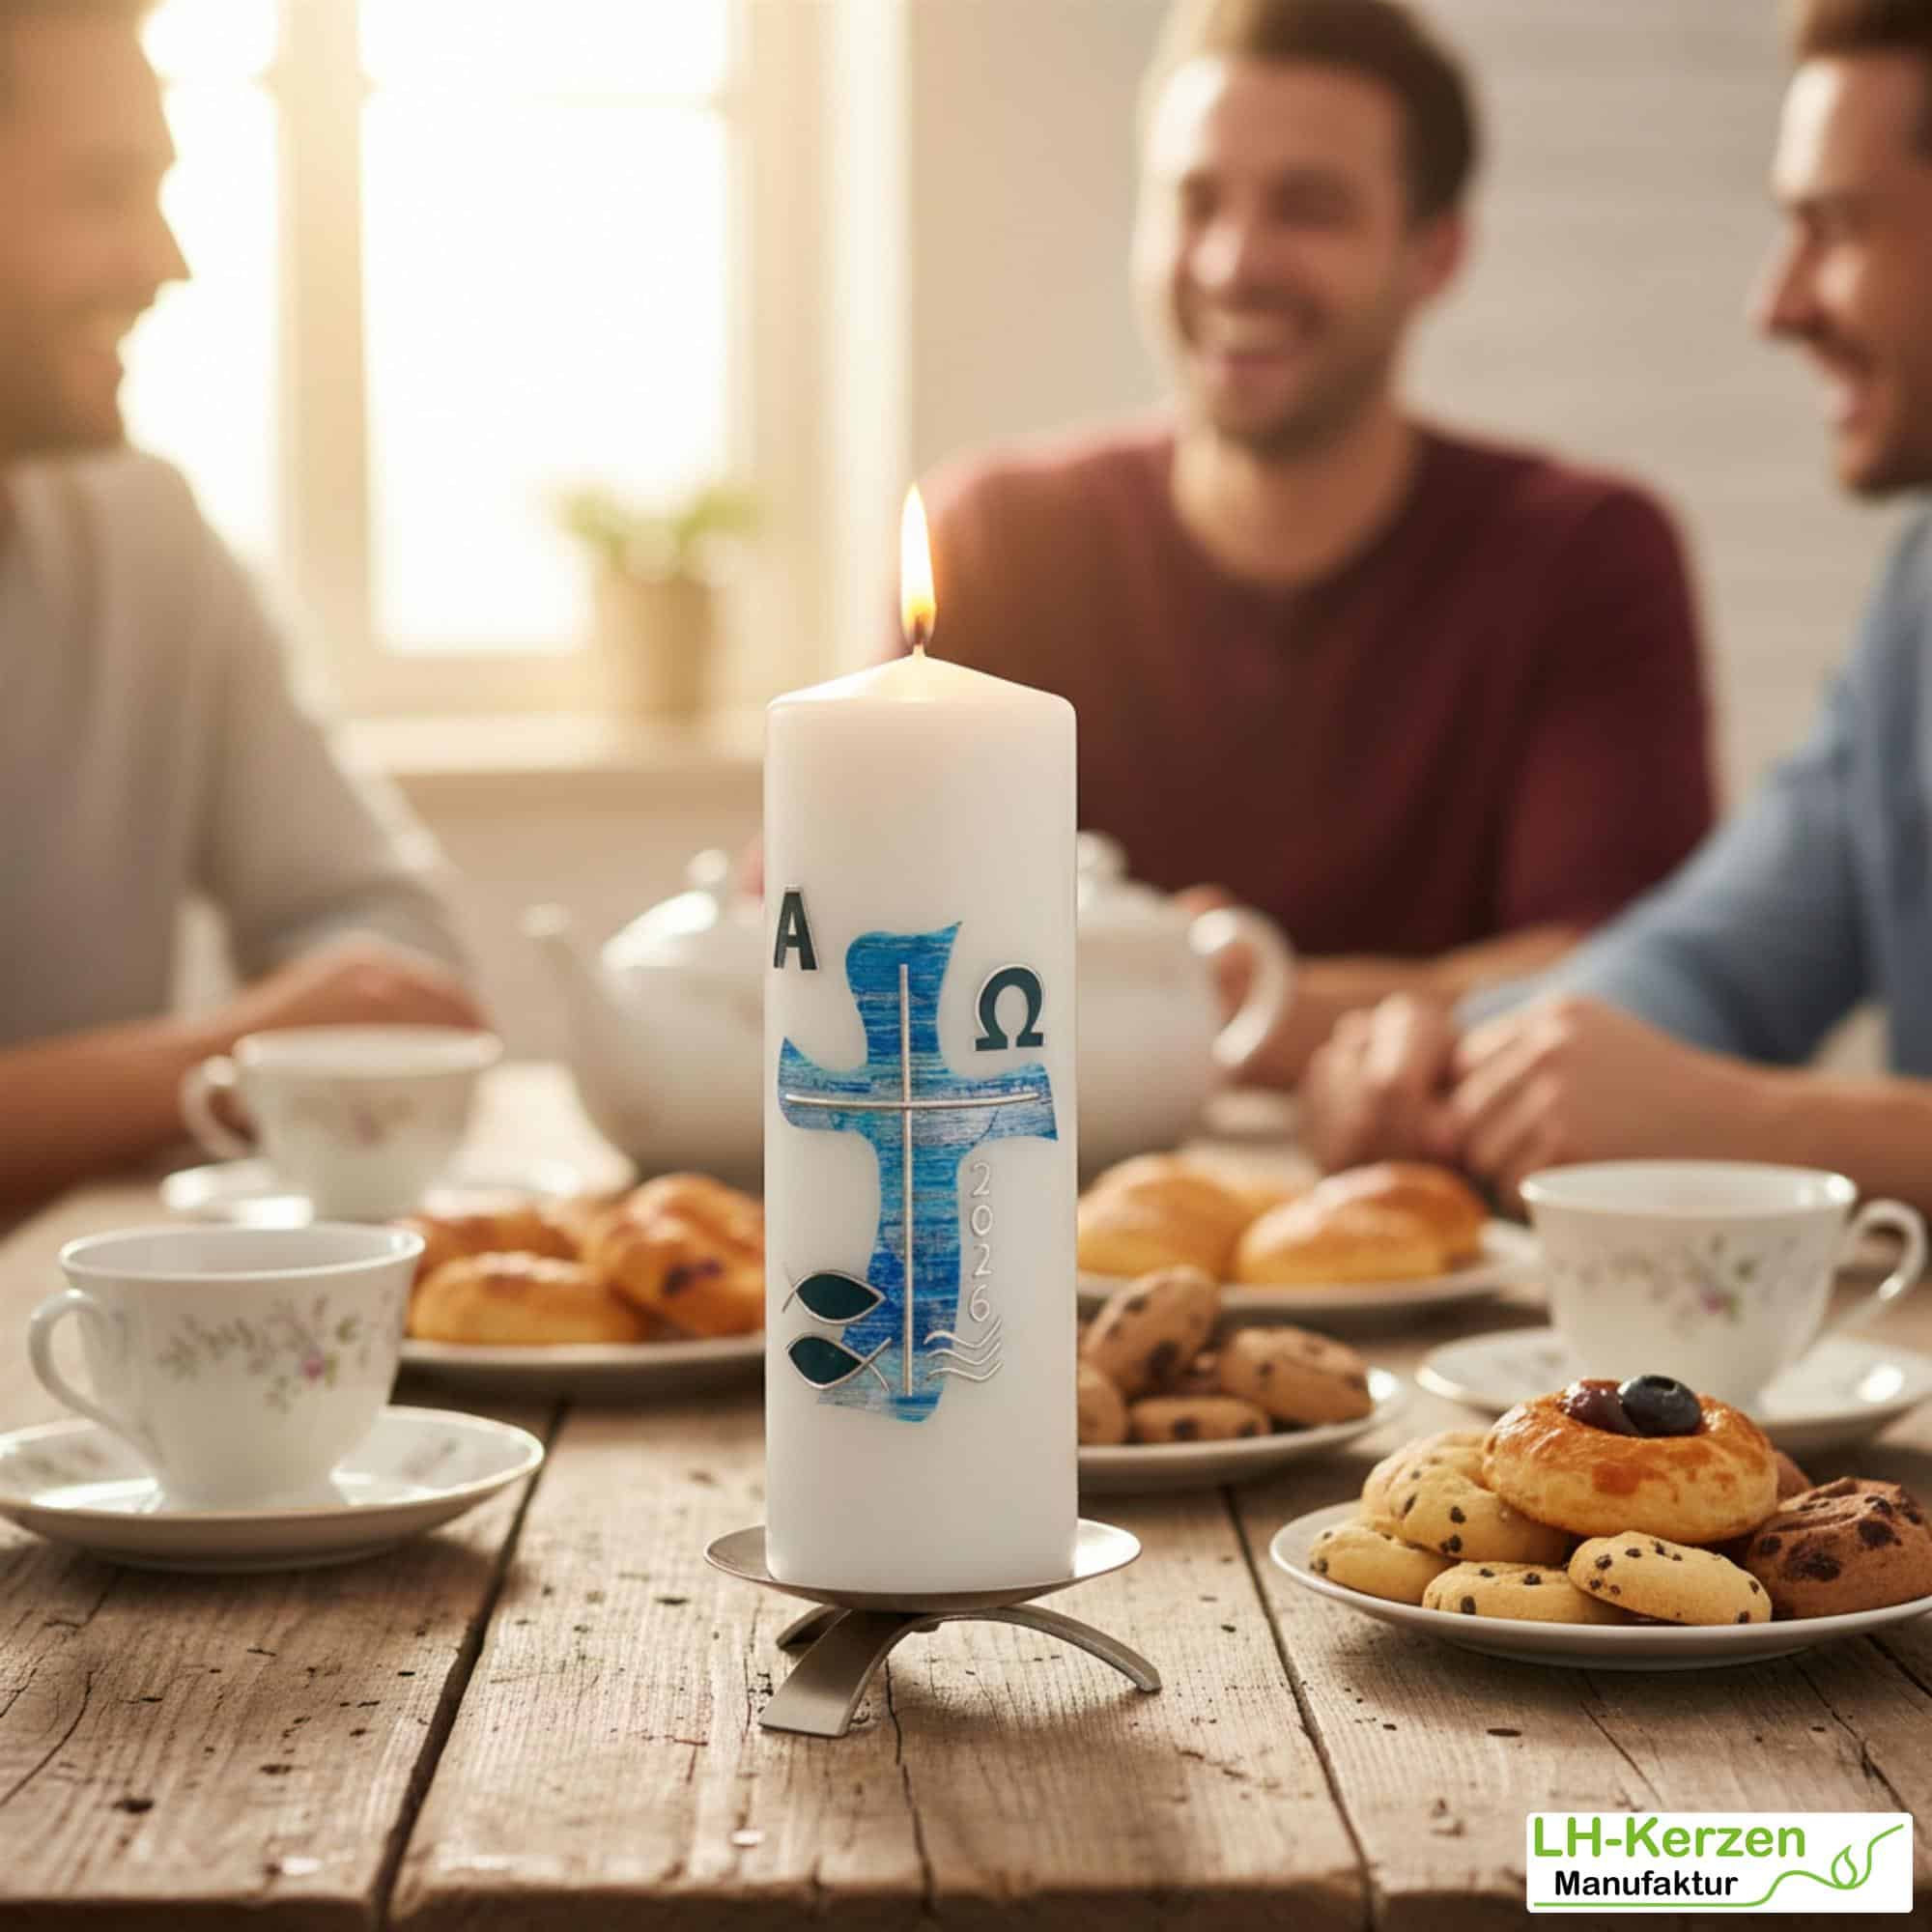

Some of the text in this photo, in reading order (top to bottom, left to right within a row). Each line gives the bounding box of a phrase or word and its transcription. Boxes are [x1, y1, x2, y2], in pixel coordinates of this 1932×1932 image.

[773, 889, 818, 971] A
[975, 965, 1044, 1052] Ω
[970, 1162, 993, 1322] 2026
